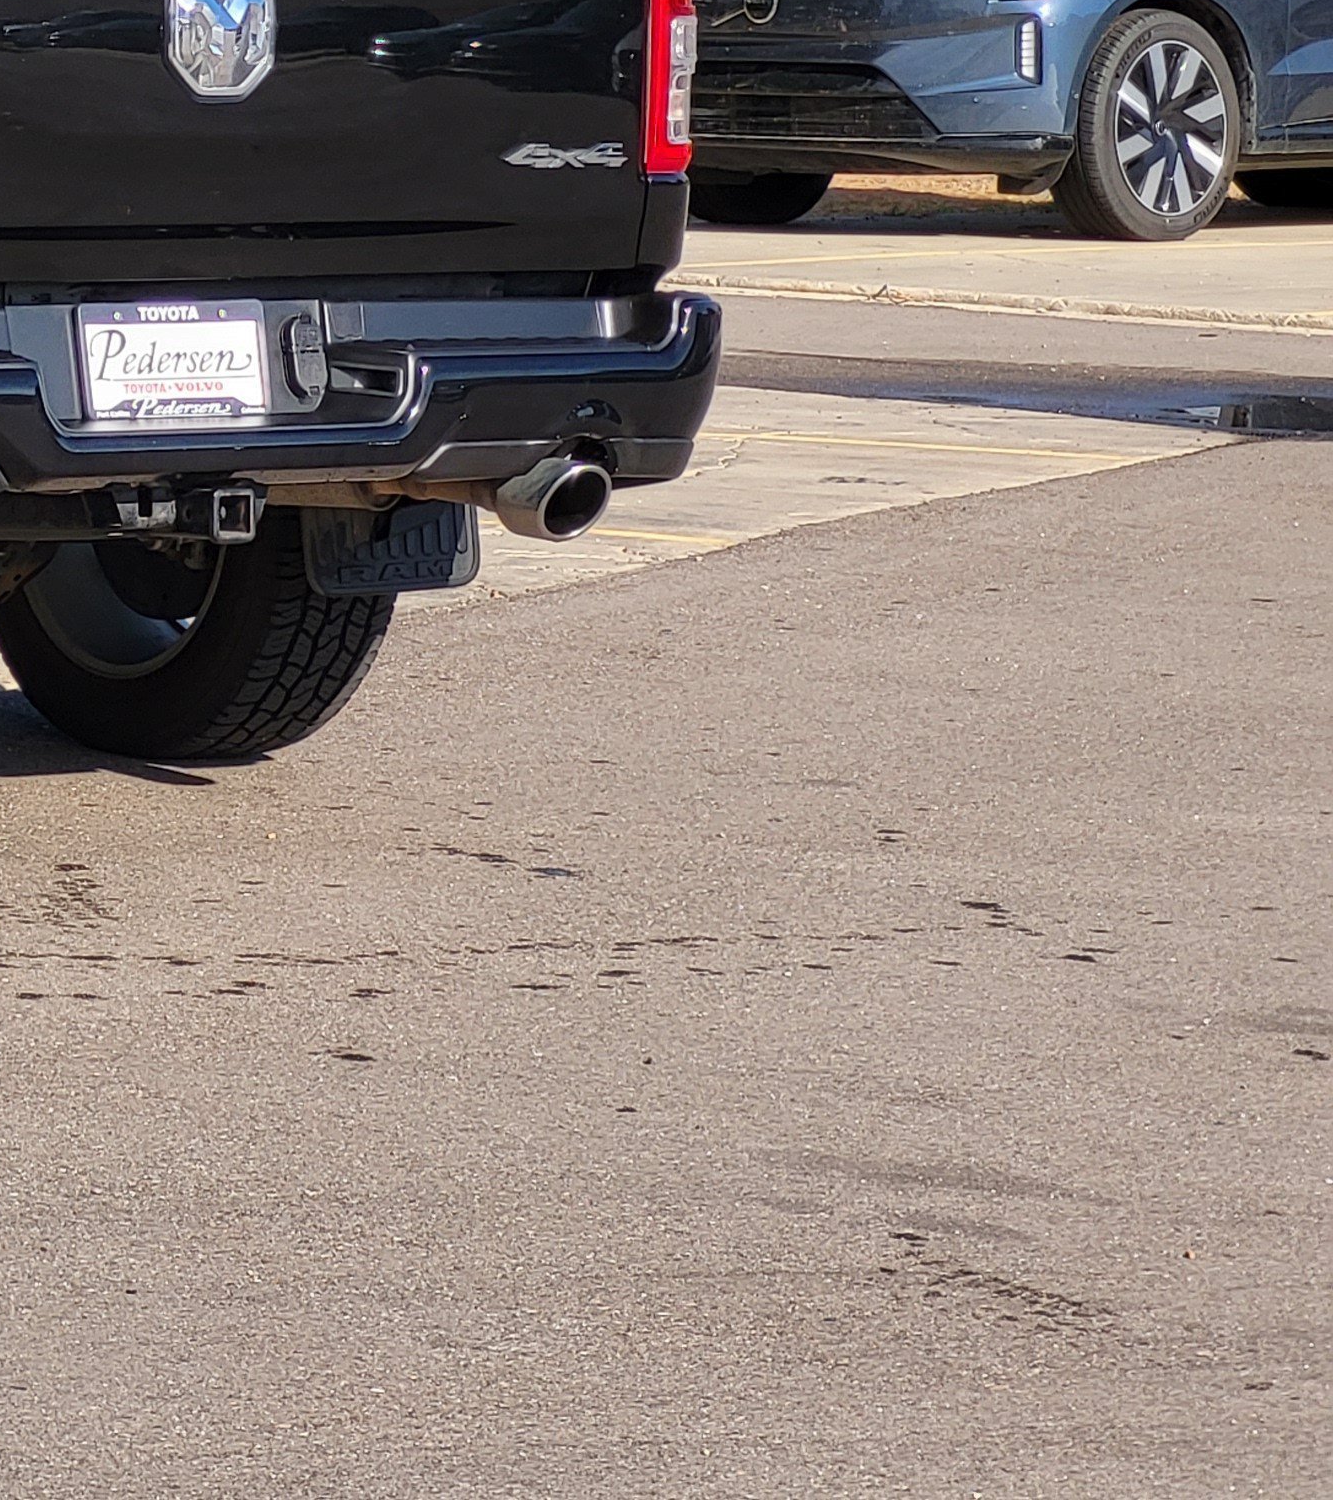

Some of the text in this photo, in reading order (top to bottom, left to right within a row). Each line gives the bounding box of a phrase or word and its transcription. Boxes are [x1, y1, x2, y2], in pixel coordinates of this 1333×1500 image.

[137, 306, 200, 321] TOYOTA
[90, 329, 253, 381] Pedersen
[124, 382, 224, 394] TOYOTA VOLVO
[132, 398, 232, 417] Pedersen
